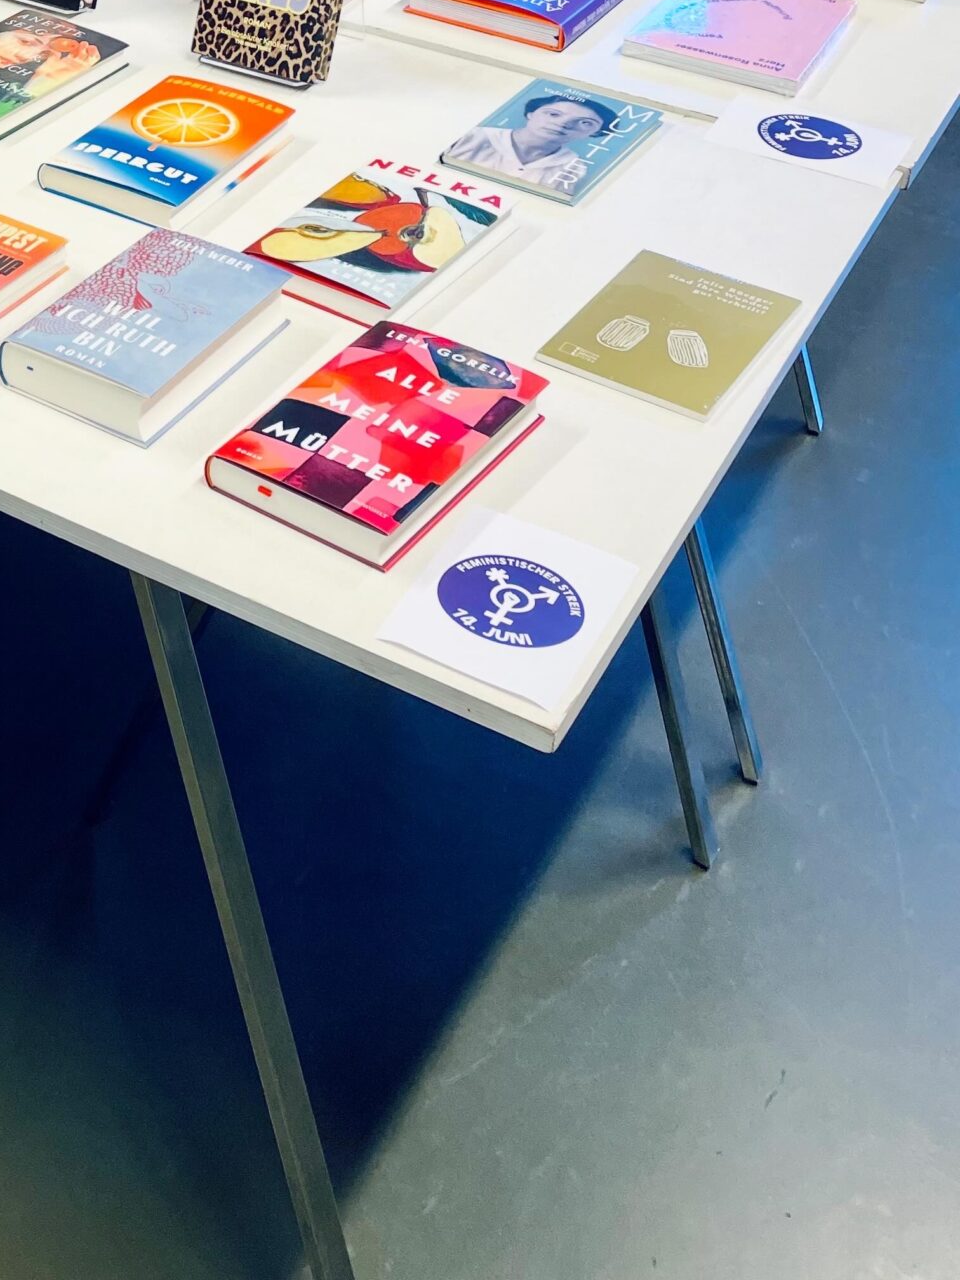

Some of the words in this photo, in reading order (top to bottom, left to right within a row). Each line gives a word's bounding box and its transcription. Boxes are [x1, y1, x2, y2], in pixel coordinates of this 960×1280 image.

[5, 19, 46, 37] SELG
[17, 13, 87, 38] ANETTE
[243, 17, 271, 29] ROMAN
[2, 63, 34, 77] ICH
[676, 43, 750, 66] Rosenwasser
[166, 76, 214, 94] SOPHIA
[73, 141, 199, 186] SPERRGUT
[548, 104, 656, 190] MUTTER
[368, 158, 504, 210] NELKA
[207, 249, 255, 272] WEBER
[667, 273, 694, 286] Sind
[724, 291, 770, 312] Wunden
[691, 288, 712, 298] gut
[55, 303, 104, 329] ICH
[105, 322, 178, 358] RUTH
[72, 330, 122, 358] BIN
[55, 344, 107, 370] ROMAN
[385, 328, 431, 351] LENA
[435, 347, 521, 384] GORELIK
[375, 366, 461, 406] ALLE
[318, 392, 442, 450] MEINE
[261, 420, 415, 494] MÜTTER
[455, 554, 564, 586] FEMINISTISCHER
[557, 582, 583, 619] STREIK
[450, 606, 477, 633] 14.
[481, 624, 534, 647] JUNI
